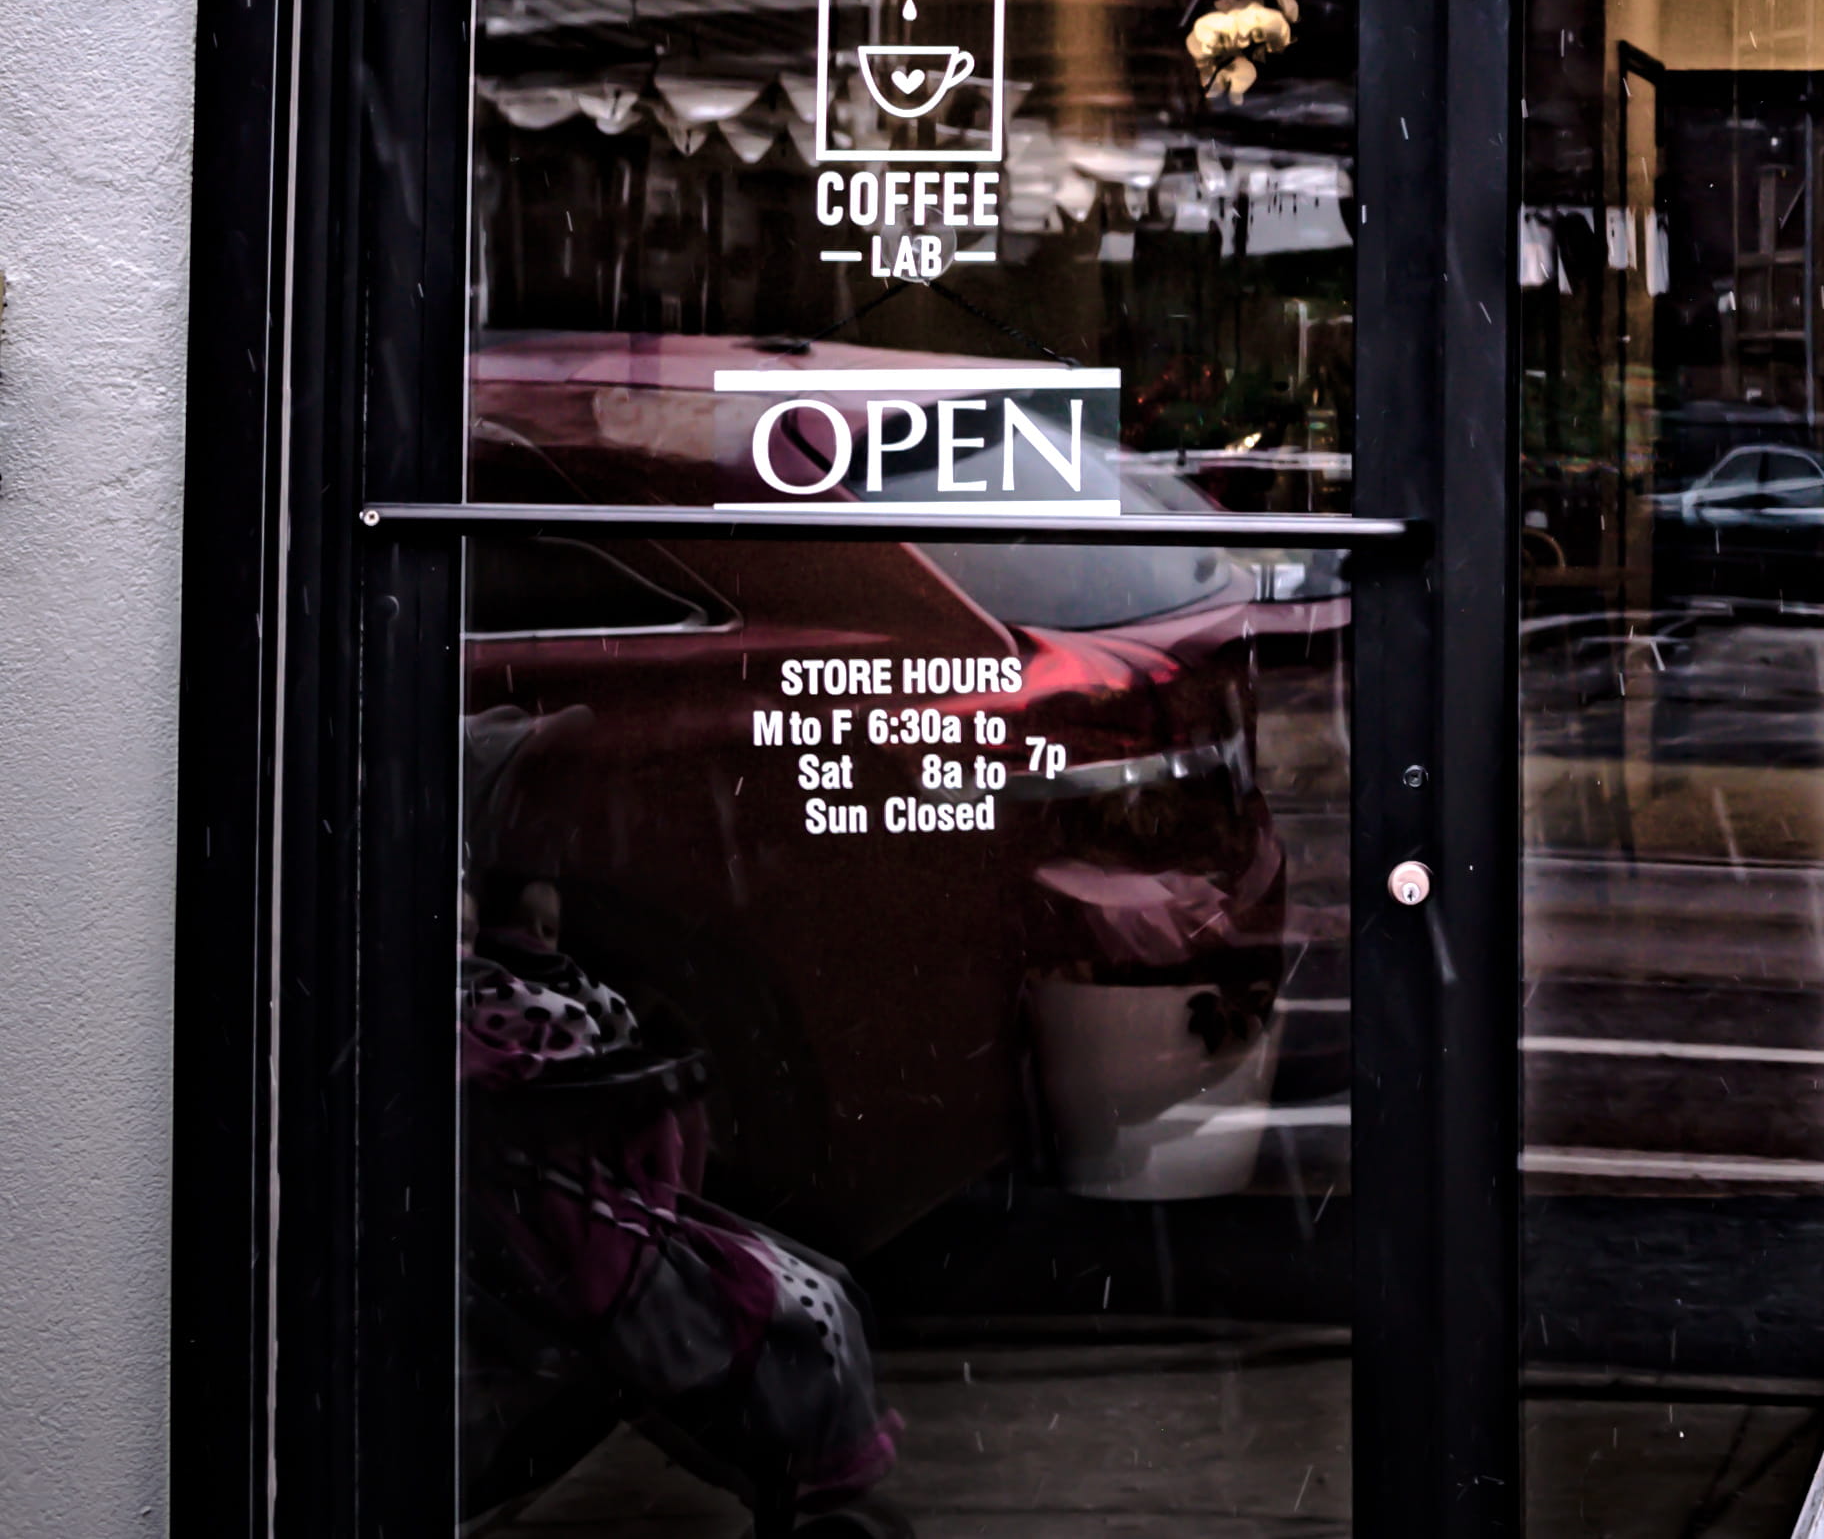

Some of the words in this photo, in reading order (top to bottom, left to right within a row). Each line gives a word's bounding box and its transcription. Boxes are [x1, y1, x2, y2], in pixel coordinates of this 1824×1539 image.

[817, 171, 999, 226] COFFEE
[872, 235, 942, 278] LAB
[753, 399, 1082, 493] OPEN
[781, 658, 892, 696] STORE
[903, 657, 1023, 694] HOURS
[753, 710, 783, 746] M
[789, 711, 822, 746] to
[832, 709, 852, 745] F
[868, 708, 962, 744] 6:30a
[973, 710, 1006, 745] to
[798, 753, 853, 790] Sat
[921, 754, 963, 790] 8a
[974, 755, 1006, 790] to
[1025, 736, 1066, 779] 7p
[805, 798, 868, 834] Sun
[885, 794, 995, 833] Closed
